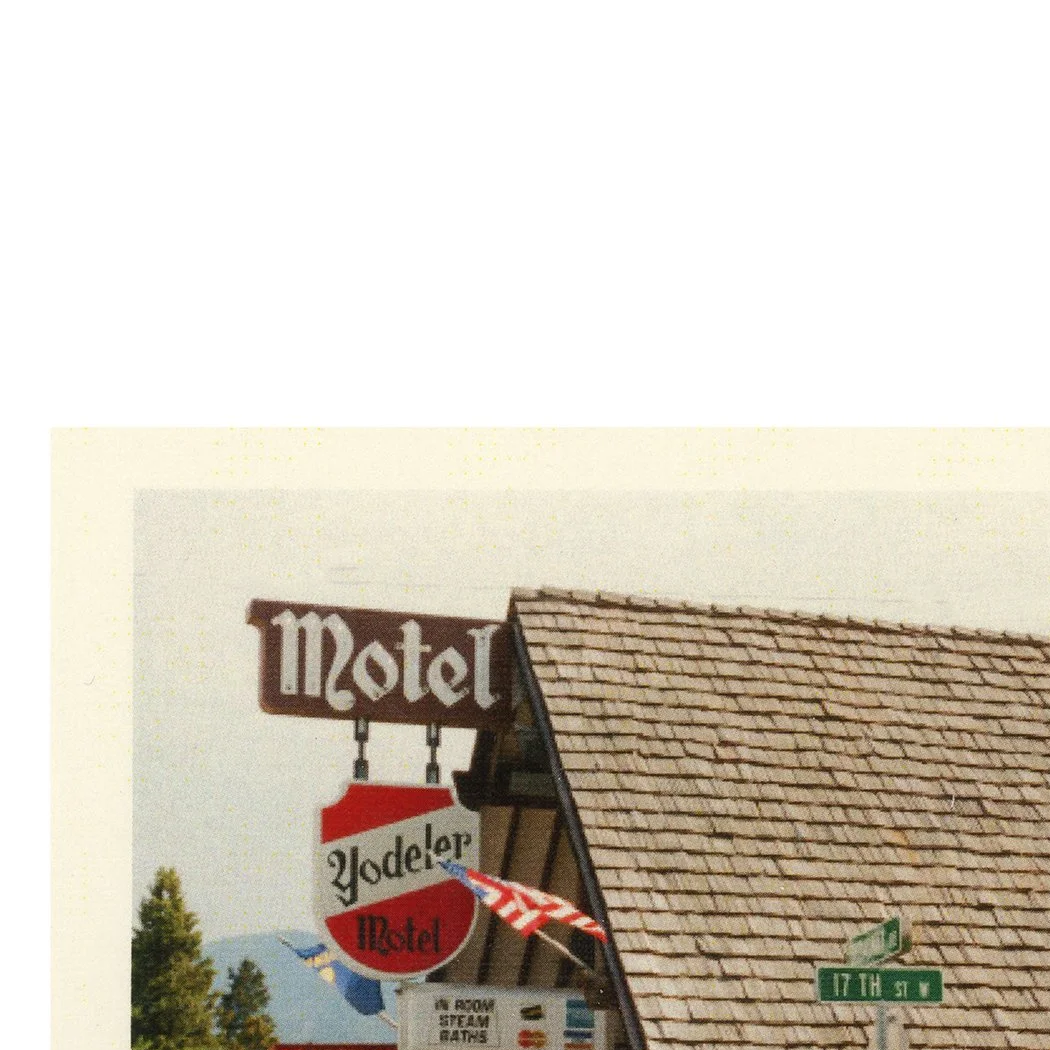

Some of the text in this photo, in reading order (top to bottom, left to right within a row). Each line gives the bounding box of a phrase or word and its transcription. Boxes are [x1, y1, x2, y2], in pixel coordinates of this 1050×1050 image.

[271, 608, 500, 711] Motel
[327, 822, 472, 908] Yodeler
[357, 914, 440, 956] Motel
[833, 973, 849, 997] 17
[859, 973, 882, 998] TH
[434, 998, 495, 1013] IN ROOM
[439, 1014, 490, 1029] STEAM
[439, 1029, 488, 1044] BATHS
